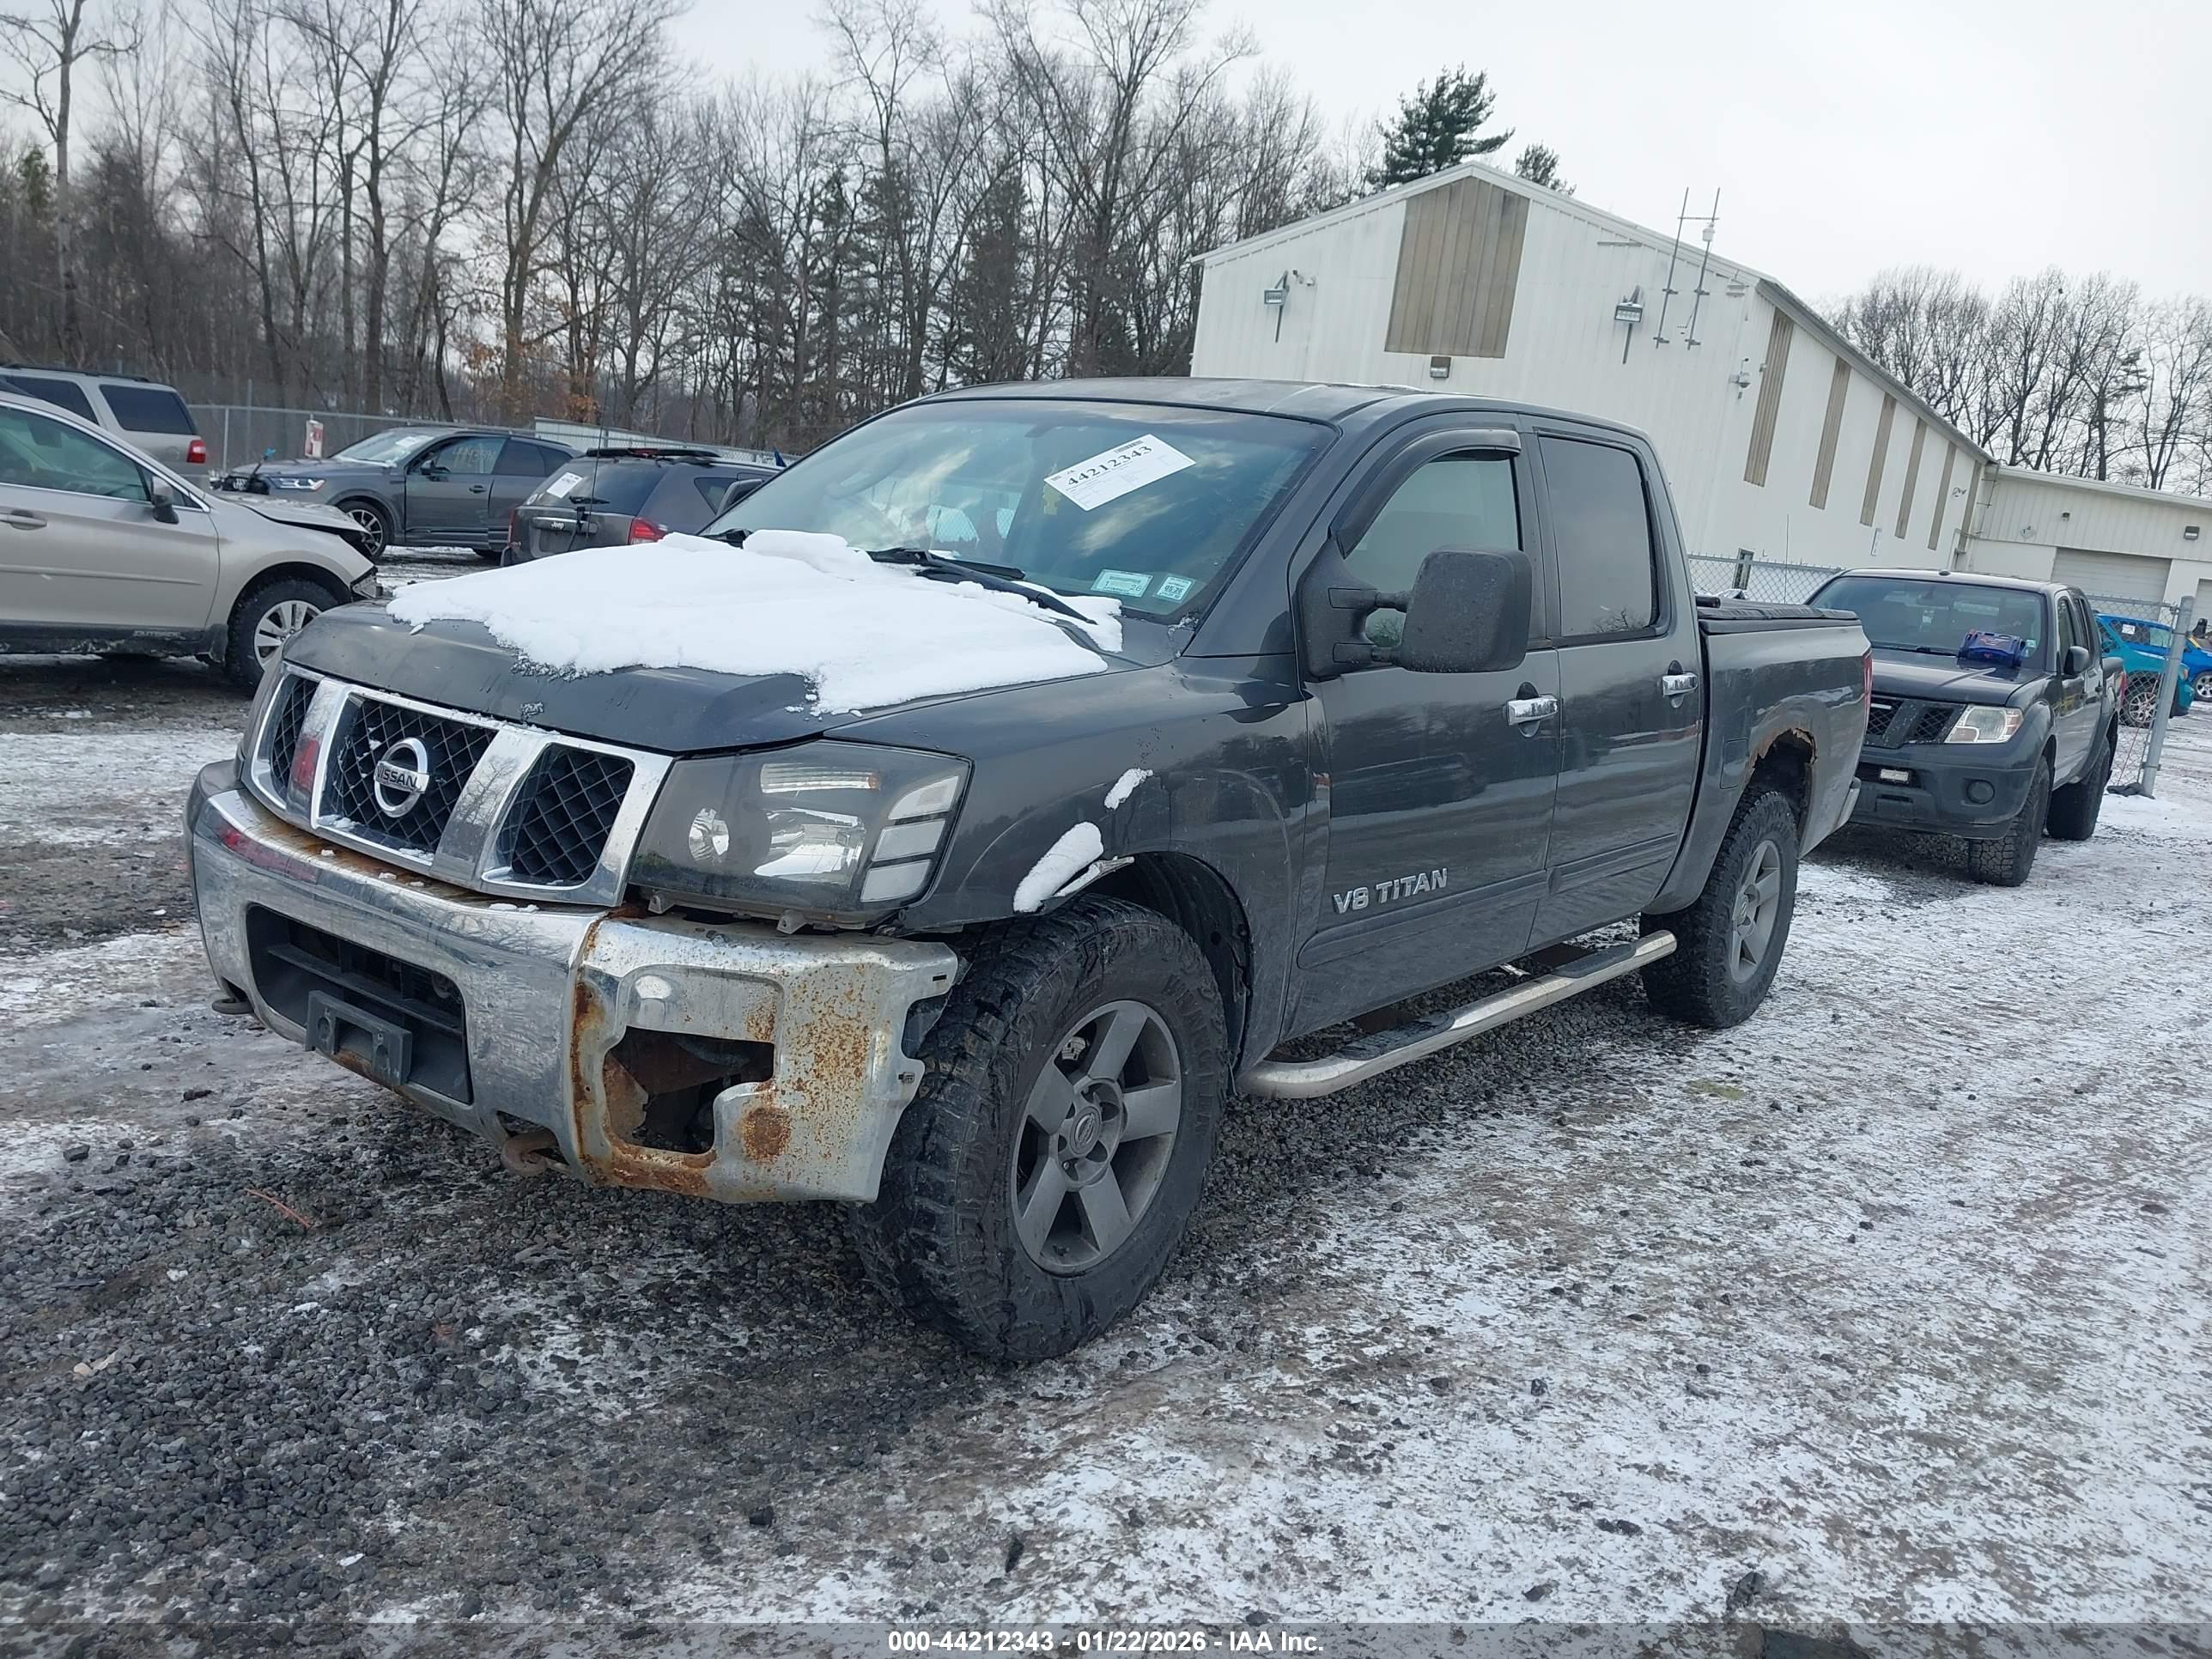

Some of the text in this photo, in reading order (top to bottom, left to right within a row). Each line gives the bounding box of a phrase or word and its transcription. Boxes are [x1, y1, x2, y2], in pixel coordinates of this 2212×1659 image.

[1068, 446, 1152, 485] 44212343
[550, 521, 565, 530] Jeep
[377, 763, 418, 788] NISSAN
[1333, 868, 1448, 915] V8 TITAN
